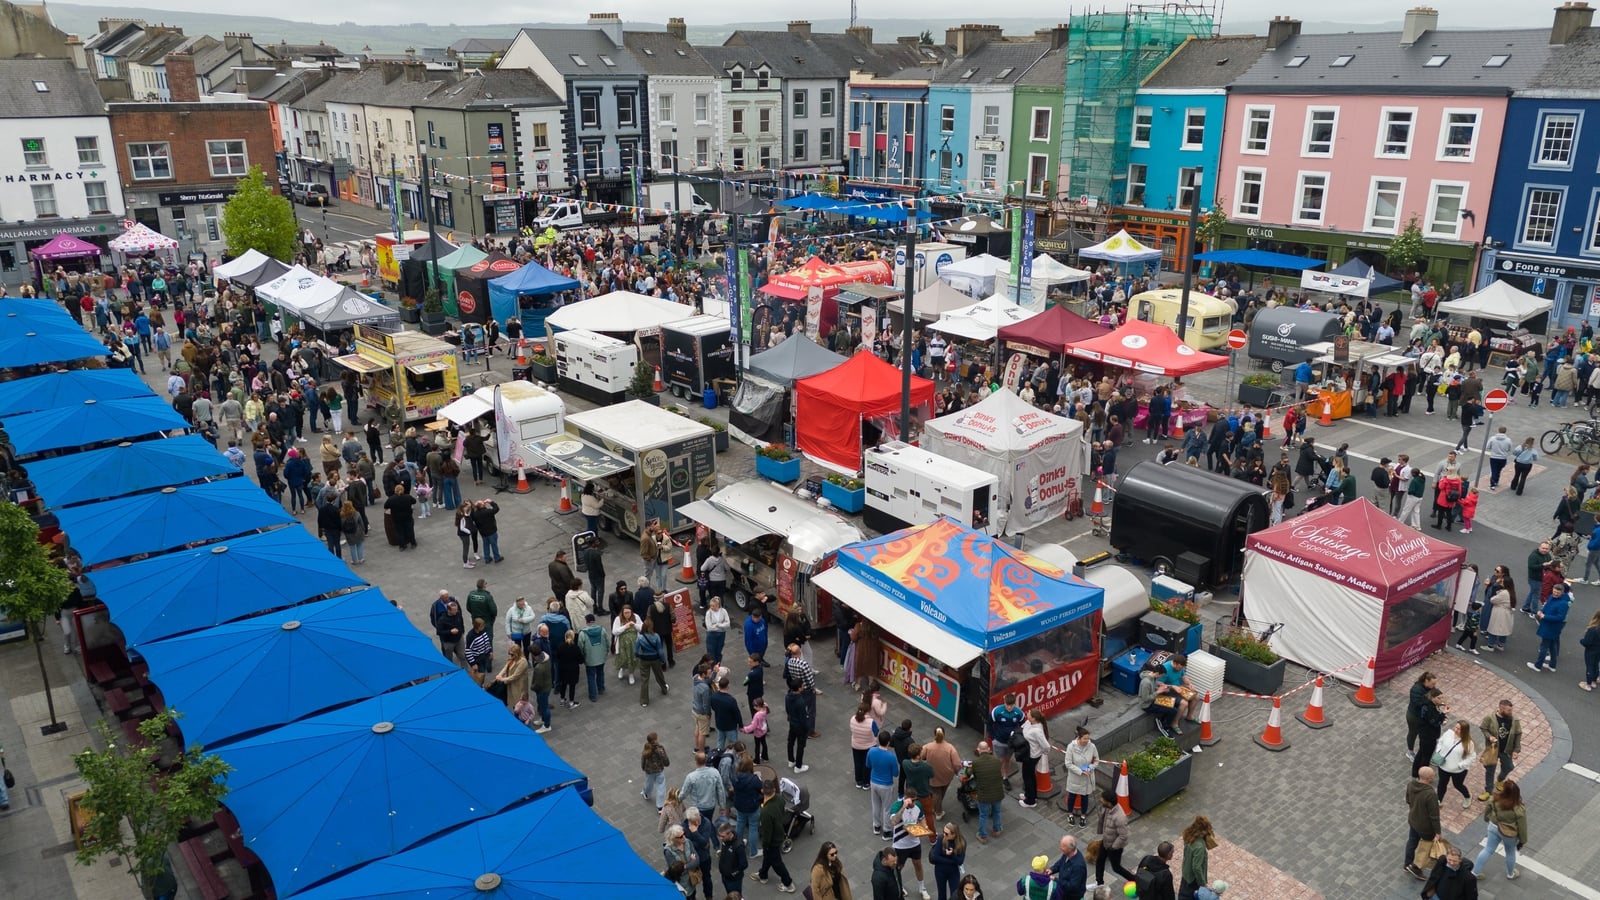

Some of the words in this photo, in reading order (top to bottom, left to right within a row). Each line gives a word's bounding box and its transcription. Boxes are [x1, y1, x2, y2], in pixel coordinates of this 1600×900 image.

[892, 146, 898, 161] 2
[0, 172, 84, 183] HARMACY
[1142, 216, 1173, 225] ENTERPRISE
[51, 225, 96, 235] PHARMACY
[1038, 240, 1067, 250] seaweed
[1515, 262, 1540, 272] Fone
[1544, 265, 1566, 275] care
[1007, 353, 1021, 389] Donu
[973, 411, 997, 423] Dinky
[1018, 412, 1039, 423] Dinky
[1025, 417, 1052, 430] Donuts
[967, 419, 997, 433] Donuts
[1039, 465, 1066, 486] Dinky
[1039, 477, 1076, 501] Donuts
[1326, 526, 1351, 539] The
[1290, 525, 1371, 559] Sausage
[1298, 540, 1349, 562] Experience
[1378, 536, 1430, 566] Sausage
[1254, 541, 1286, 559] Authentic
[1286, 554, 1313, 569] Artisan
[1314, 563, 1346, 580] Sausage
[1346, 575, 1377, 592] Makers
[891, 588, 906, 601] PIZZA
[920, 600, 947, 623] Volcano
[993, 630, 1016, 643] Volcano
[880, 649, 932, 694] lcano
[910, 686, 930, 704] PIZZA
